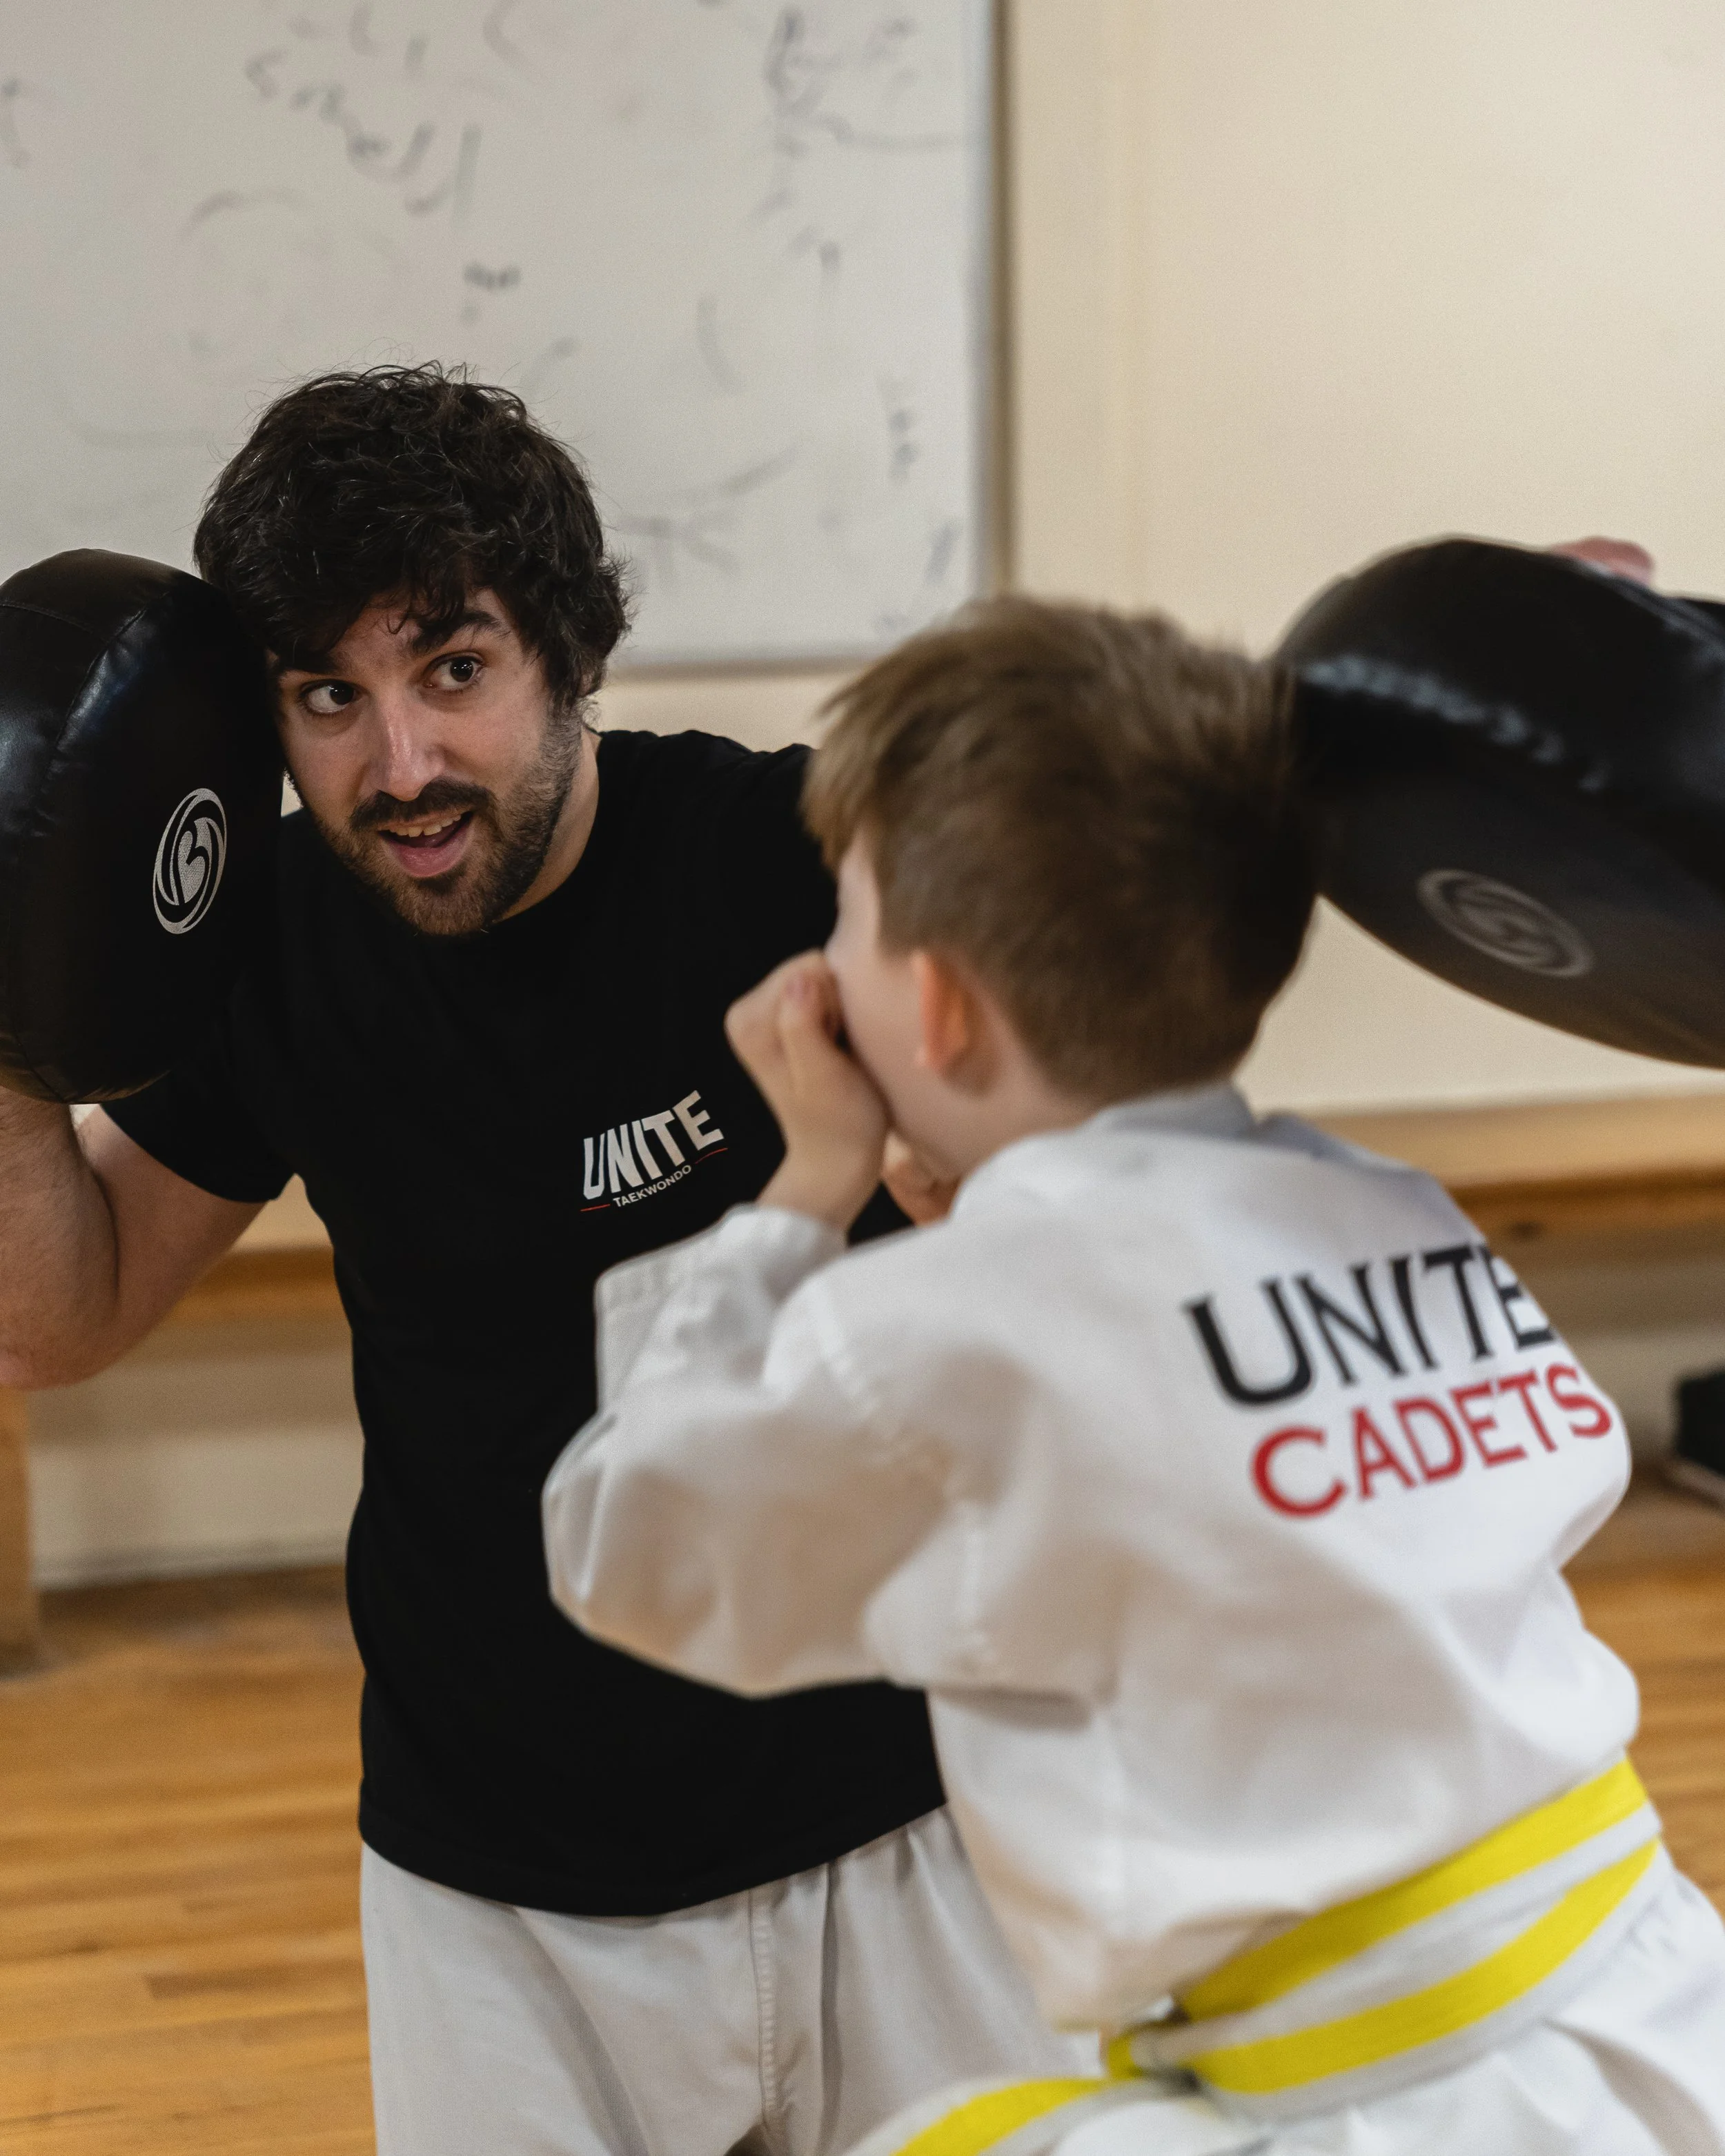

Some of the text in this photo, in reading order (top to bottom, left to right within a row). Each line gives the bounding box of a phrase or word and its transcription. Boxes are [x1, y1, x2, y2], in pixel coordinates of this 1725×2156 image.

[583, 1089, 724, 1200] UNITE
[613, 1164, 692, 1207] TAEKWONDO
[1183, 1243, 1557, 1406] UNITE
[1250, 1363, 1613, 1519] CADETS
